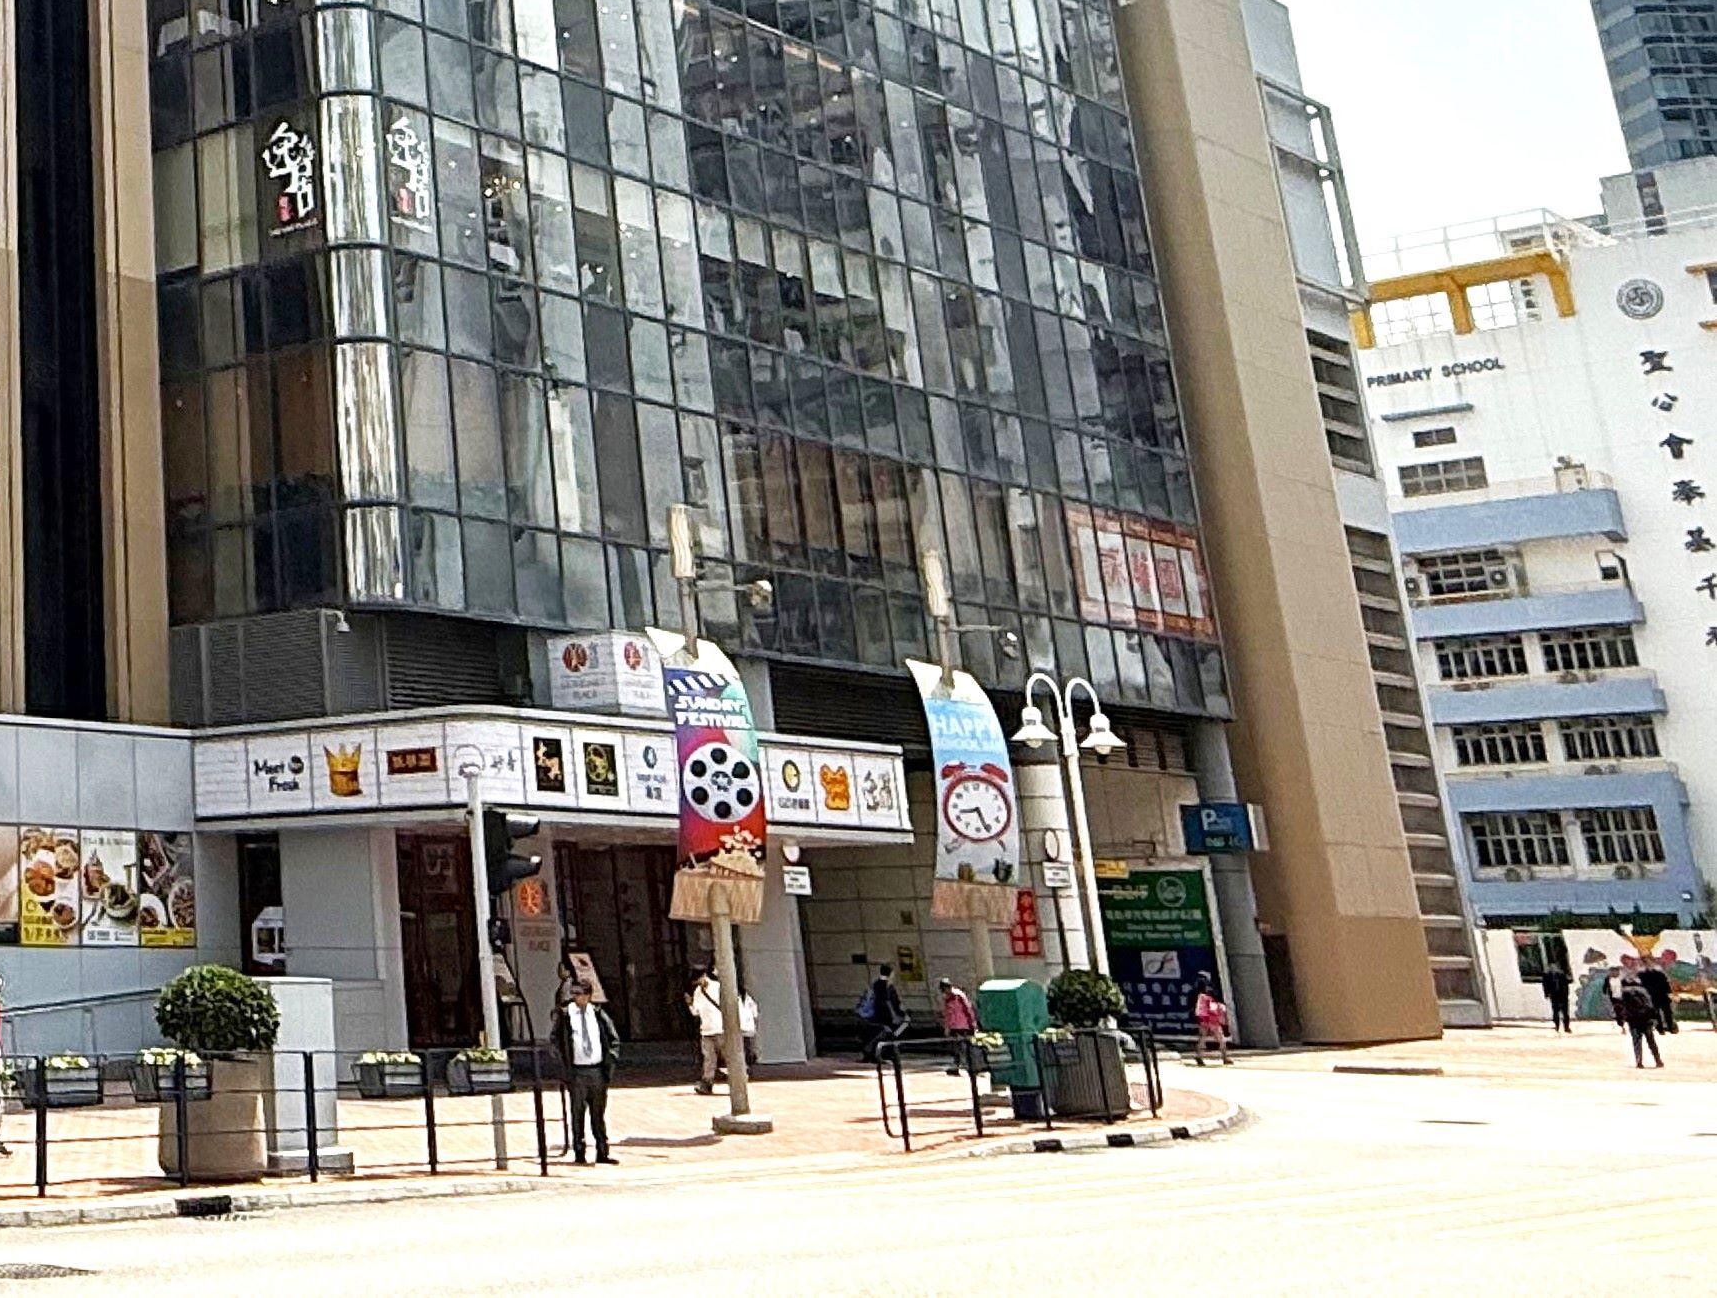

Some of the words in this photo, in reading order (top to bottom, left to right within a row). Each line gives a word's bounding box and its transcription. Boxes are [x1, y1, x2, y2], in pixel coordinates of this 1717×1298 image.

[1367, 367, 1432, 388] PRIMARY
[1441, 357, 1505, 378] SCHOOL
[674, 695, 746, 713] SUNDAY
